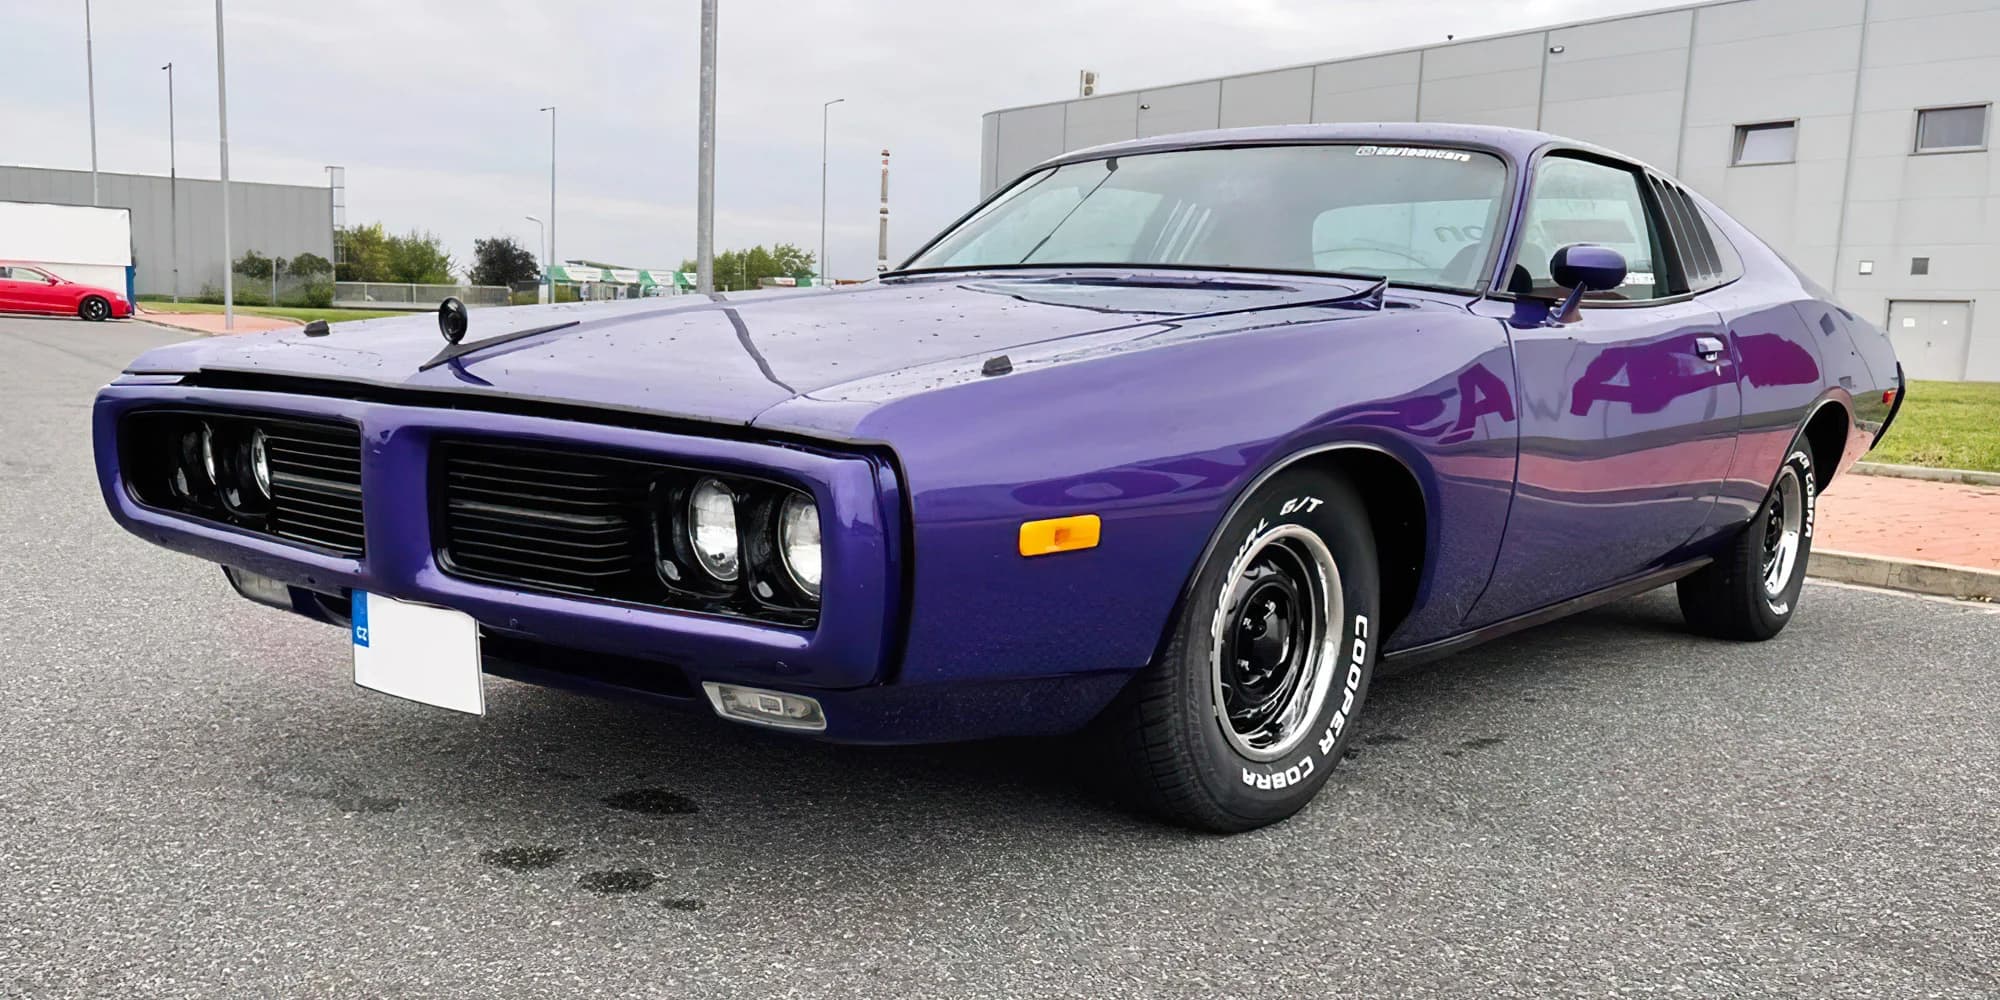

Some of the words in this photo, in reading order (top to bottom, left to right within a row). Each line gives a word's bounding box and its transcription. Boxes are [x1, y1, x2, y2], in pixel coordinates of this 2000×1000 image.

[1280, 495, 1324, 516] G/T
[356, 625, 368, 641] CZ
[1318, 614, 1368, 756] COOPER
[1242, 755, 1315, 790] COBRA
